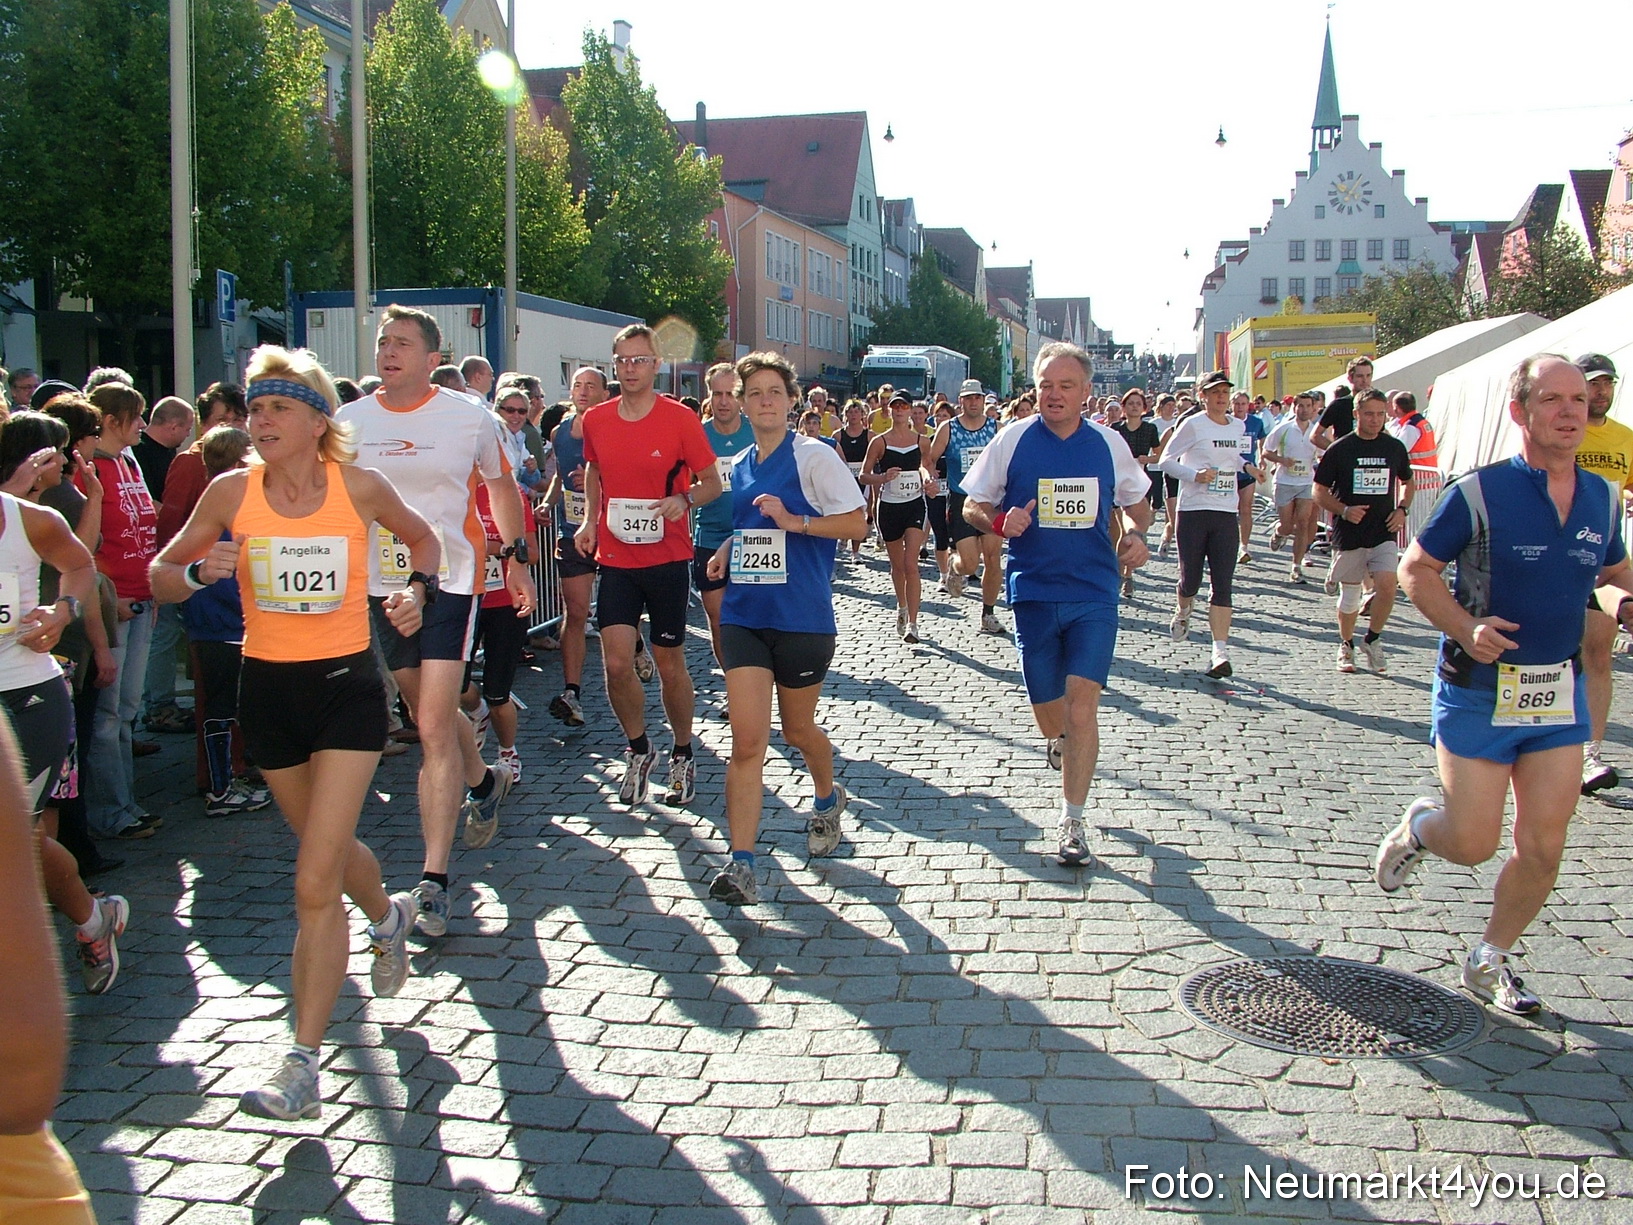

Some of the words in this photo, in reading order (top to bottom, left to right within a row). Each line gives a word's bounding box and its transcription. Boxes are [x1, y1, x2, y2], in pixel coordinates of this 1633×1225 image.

[221, 277, 231, 314] P
[1212, 440, 1238, 448] THULE
[969, 457, 978, 466] 2
[1356, 457, 1387, 466] THULE
[899, 482, 919, 491] 3479
[1363, 477, 1387, 487] 3447
[1053, 483, 1085, 493] Johann
[1041, 496, 1049, 505] C
[1055, 499, 1086, 515] 566
[623, 518, 658, 532] 3478
[742, 535, 773, 546] Martina
[280, 546, 331, 558] Angelika
[382, 548, 390, 558] C
[733, 549, 740, 559] D
[742, 553, 781, 569] 2248
[278, 570, 336, 592] 1021
[1520, 671, 1561, 685] Günther
[1502, 688, 1512, 700] C
[1517, 690, 1556, 709] 869
